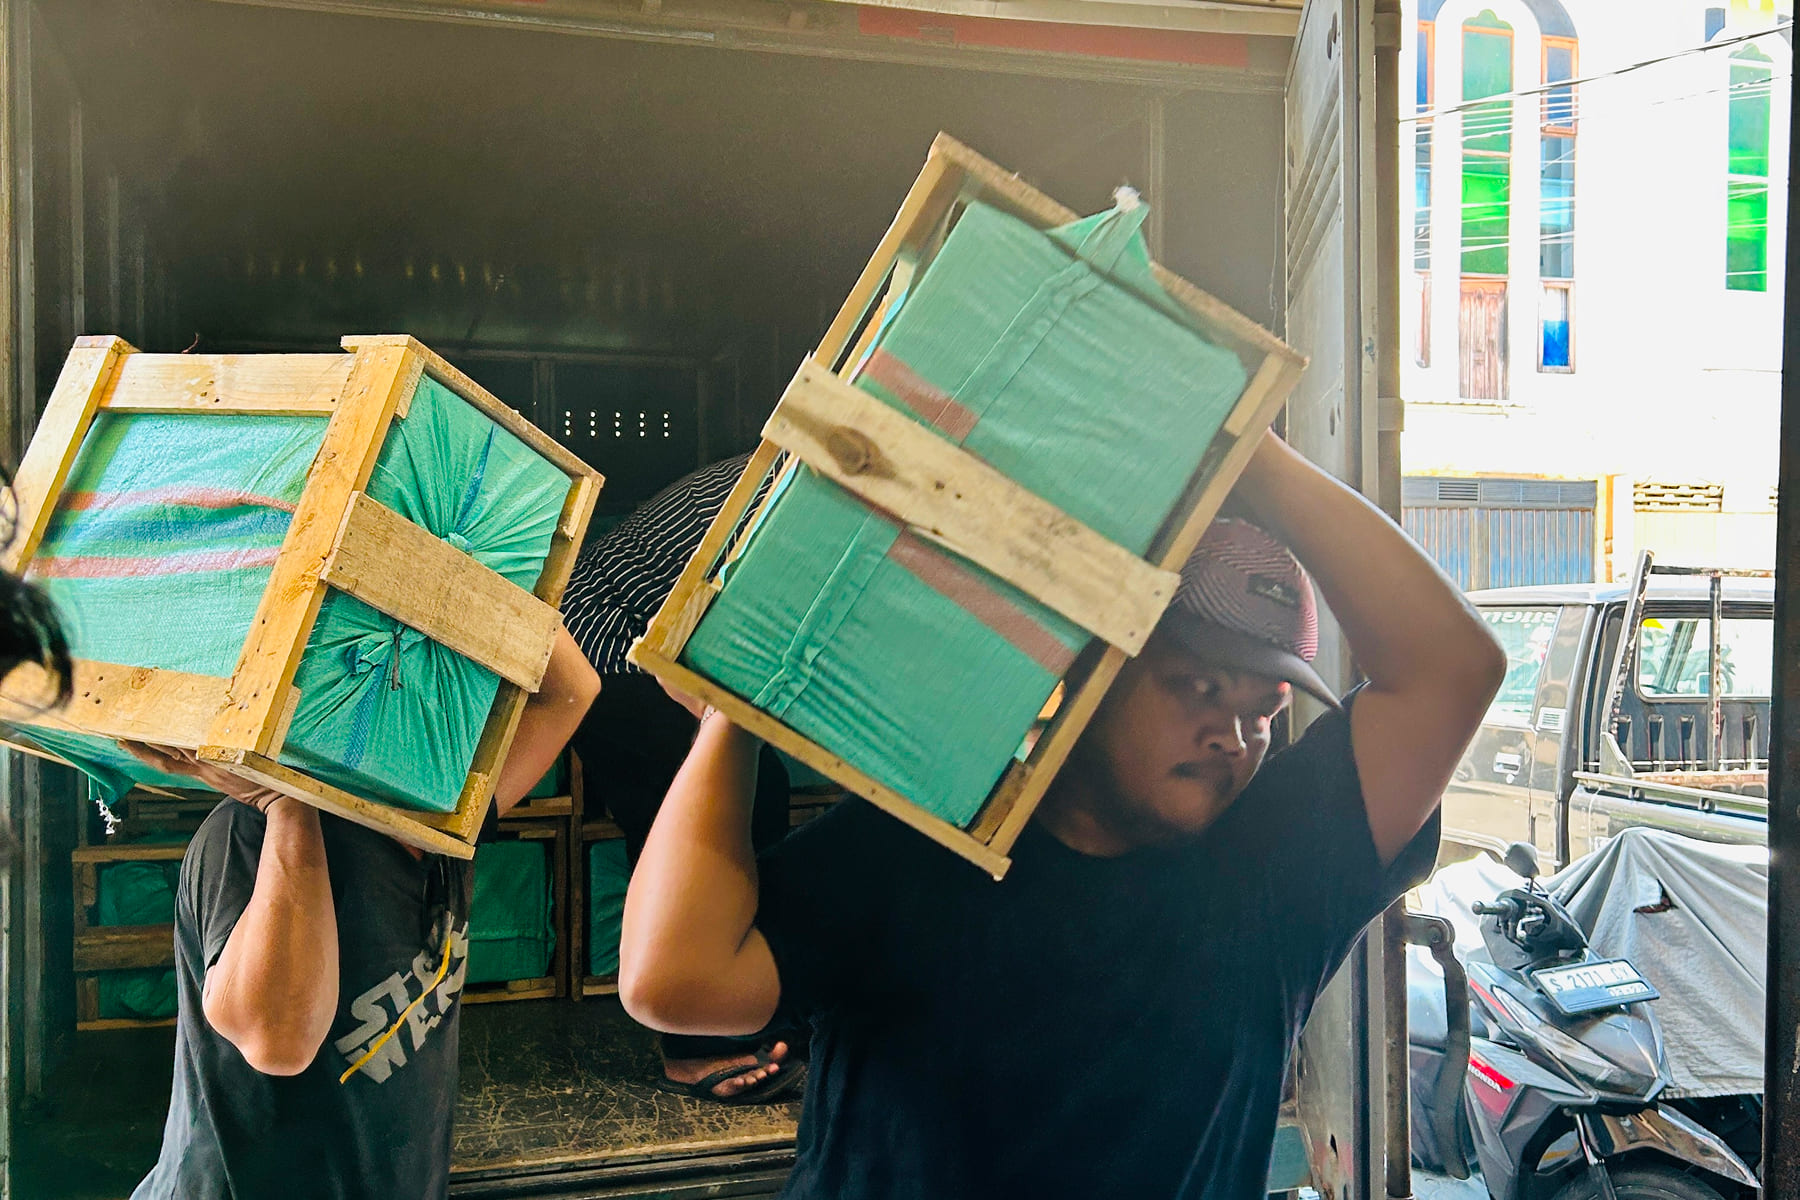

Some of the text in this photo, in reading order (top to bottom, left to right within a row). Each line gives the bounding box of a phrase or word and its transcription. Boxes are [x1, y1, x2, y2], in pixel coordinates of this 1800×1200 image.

[1549, 977, 1563, 992] S
[1567, 970, 1605, 988] 2171
[1467, 1062, 1503, 1093] HONDA
